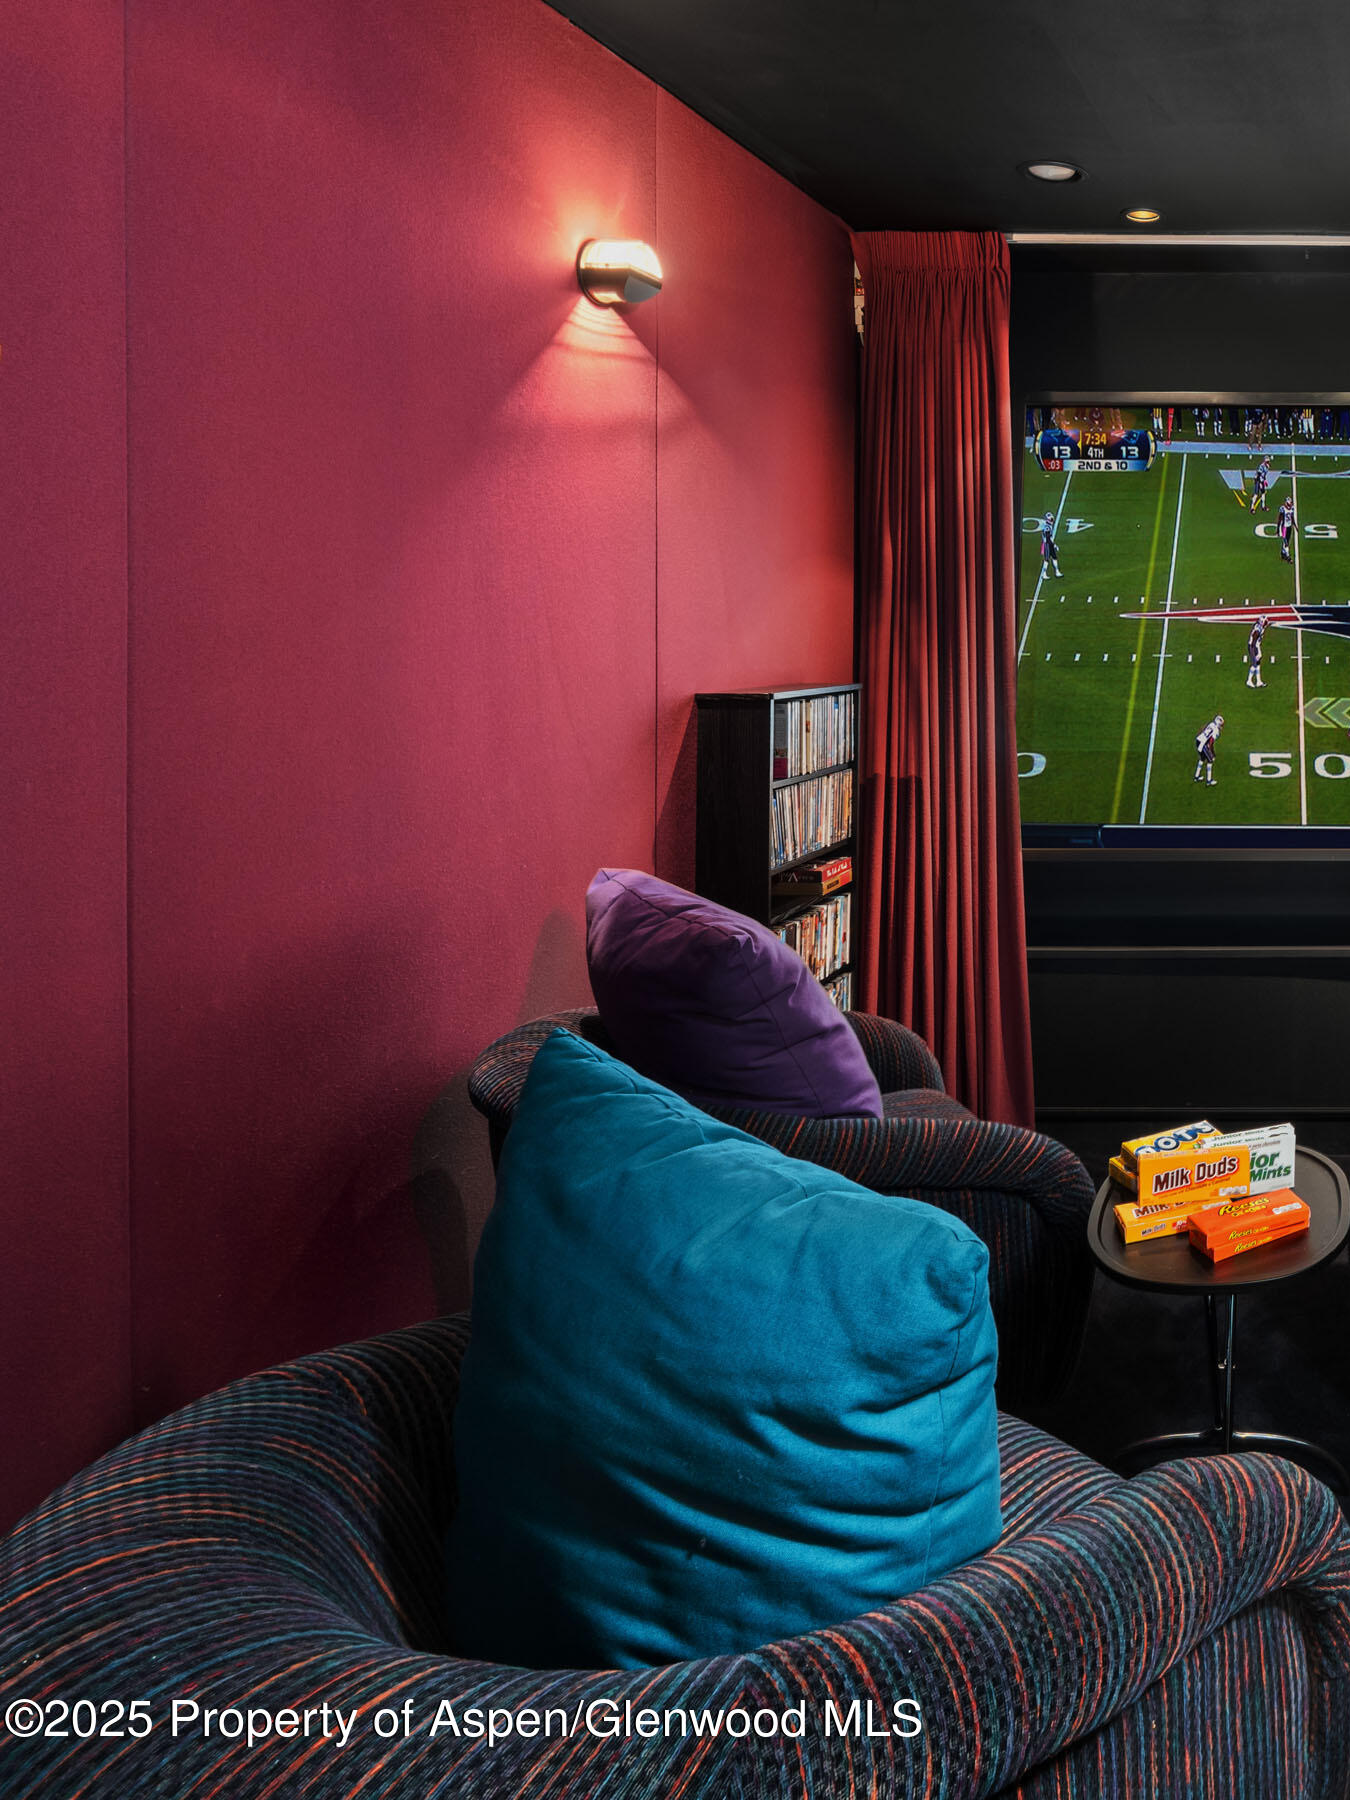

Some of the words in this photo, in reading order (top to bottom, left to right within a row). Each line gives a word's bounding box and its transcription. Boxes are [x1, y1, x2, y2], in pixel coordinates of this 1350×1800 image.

[1085, 432, 1107, 445] 7:34
[1052, 446, 1071, 459] 13
[1087, 447, 1105, 458] 4TH
[1120, 446, 1139, 459] 13
[1077, 460, 1102, 470] 2ND
[1104, 461, 1113, 470] &
[1116, 460, 1128, 470] 10
[1153, 1167, 1190, 1194] Milk
[1195, 1156, 1238, 1182] Duds
[1250, 1166, 1292, 1183] Mints
